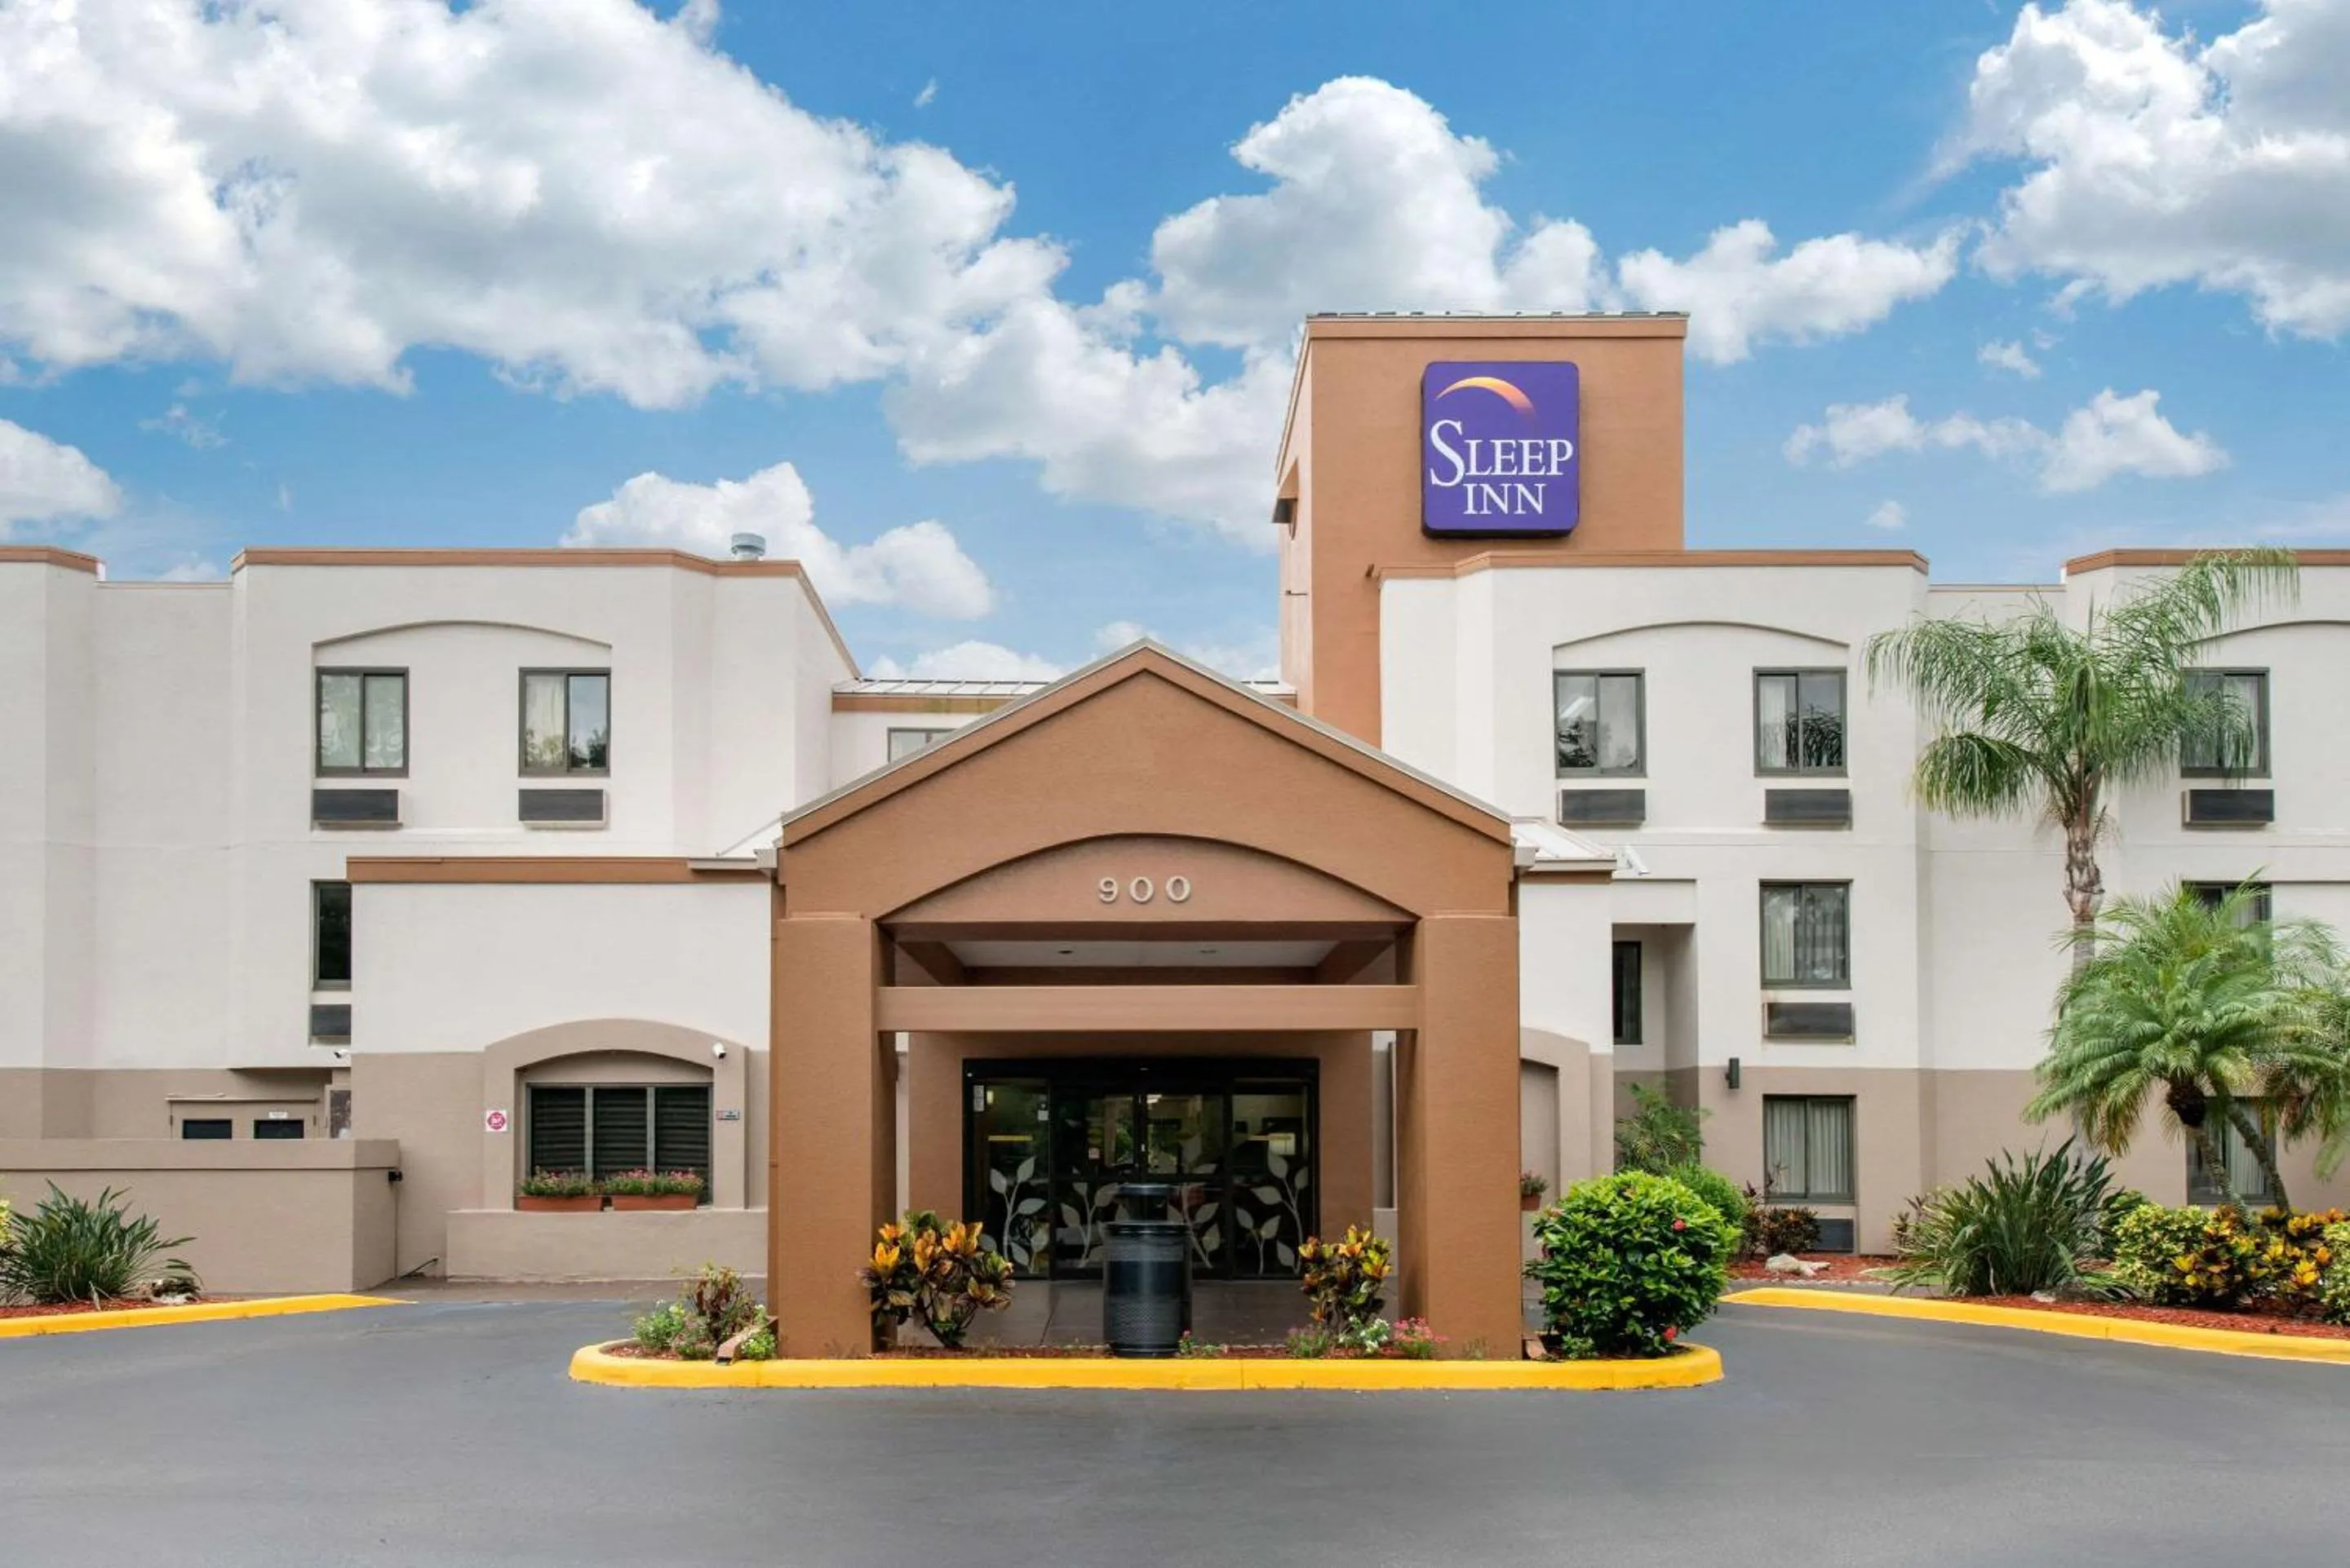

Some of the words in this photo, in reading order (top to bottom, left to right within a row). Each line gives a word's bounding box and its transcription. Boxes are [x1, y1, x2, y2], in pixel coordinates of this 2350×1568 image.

[1430, 419, 1574, 487] SLEEP
[1462, 483, 1547, 515] INN
[1098, 875, 1191, 903] 900
